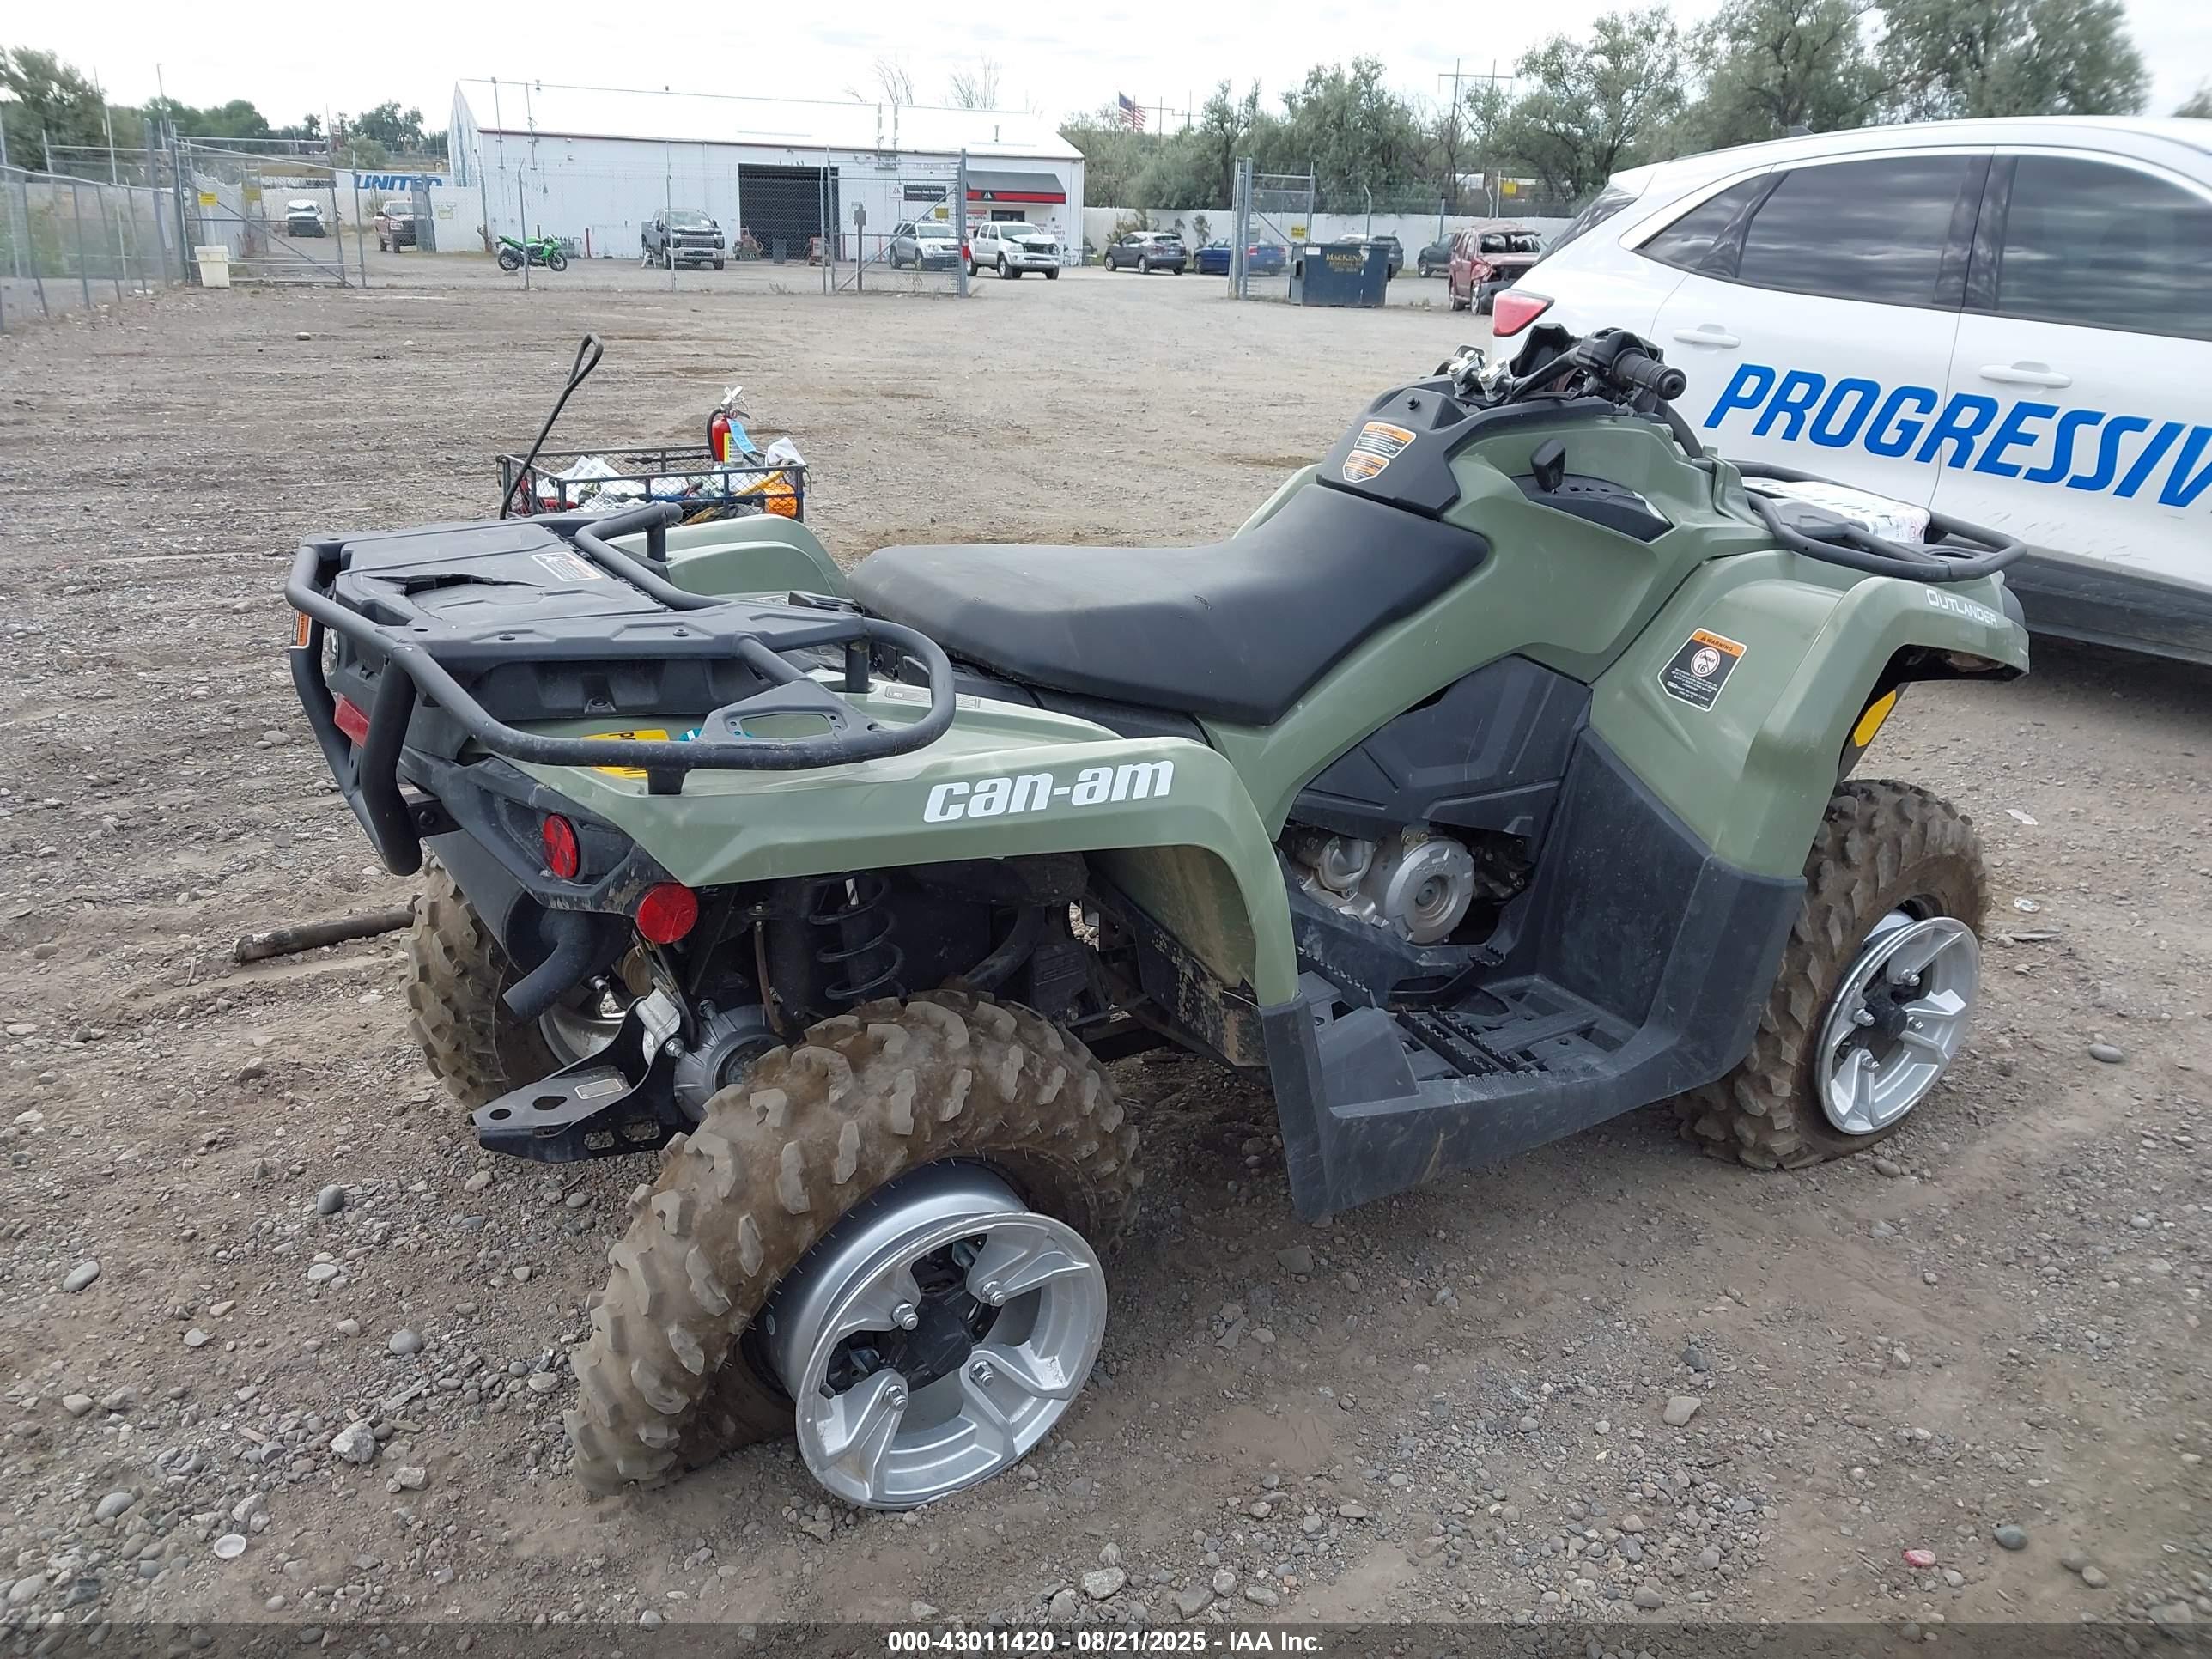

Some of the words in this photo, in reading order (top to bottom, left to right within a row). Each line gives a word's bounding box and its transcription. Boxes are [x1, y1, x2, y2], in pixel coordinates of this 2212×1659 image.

[1704, 363, 2212, 507] PROGRESSIV
[1926, 588, 1998, 629] OUTLANDER
[1705, 635, 1734, 653] WARNING
[1697, 663, 1707, 673] 16
[923, 760, 1175, 823] can-am
